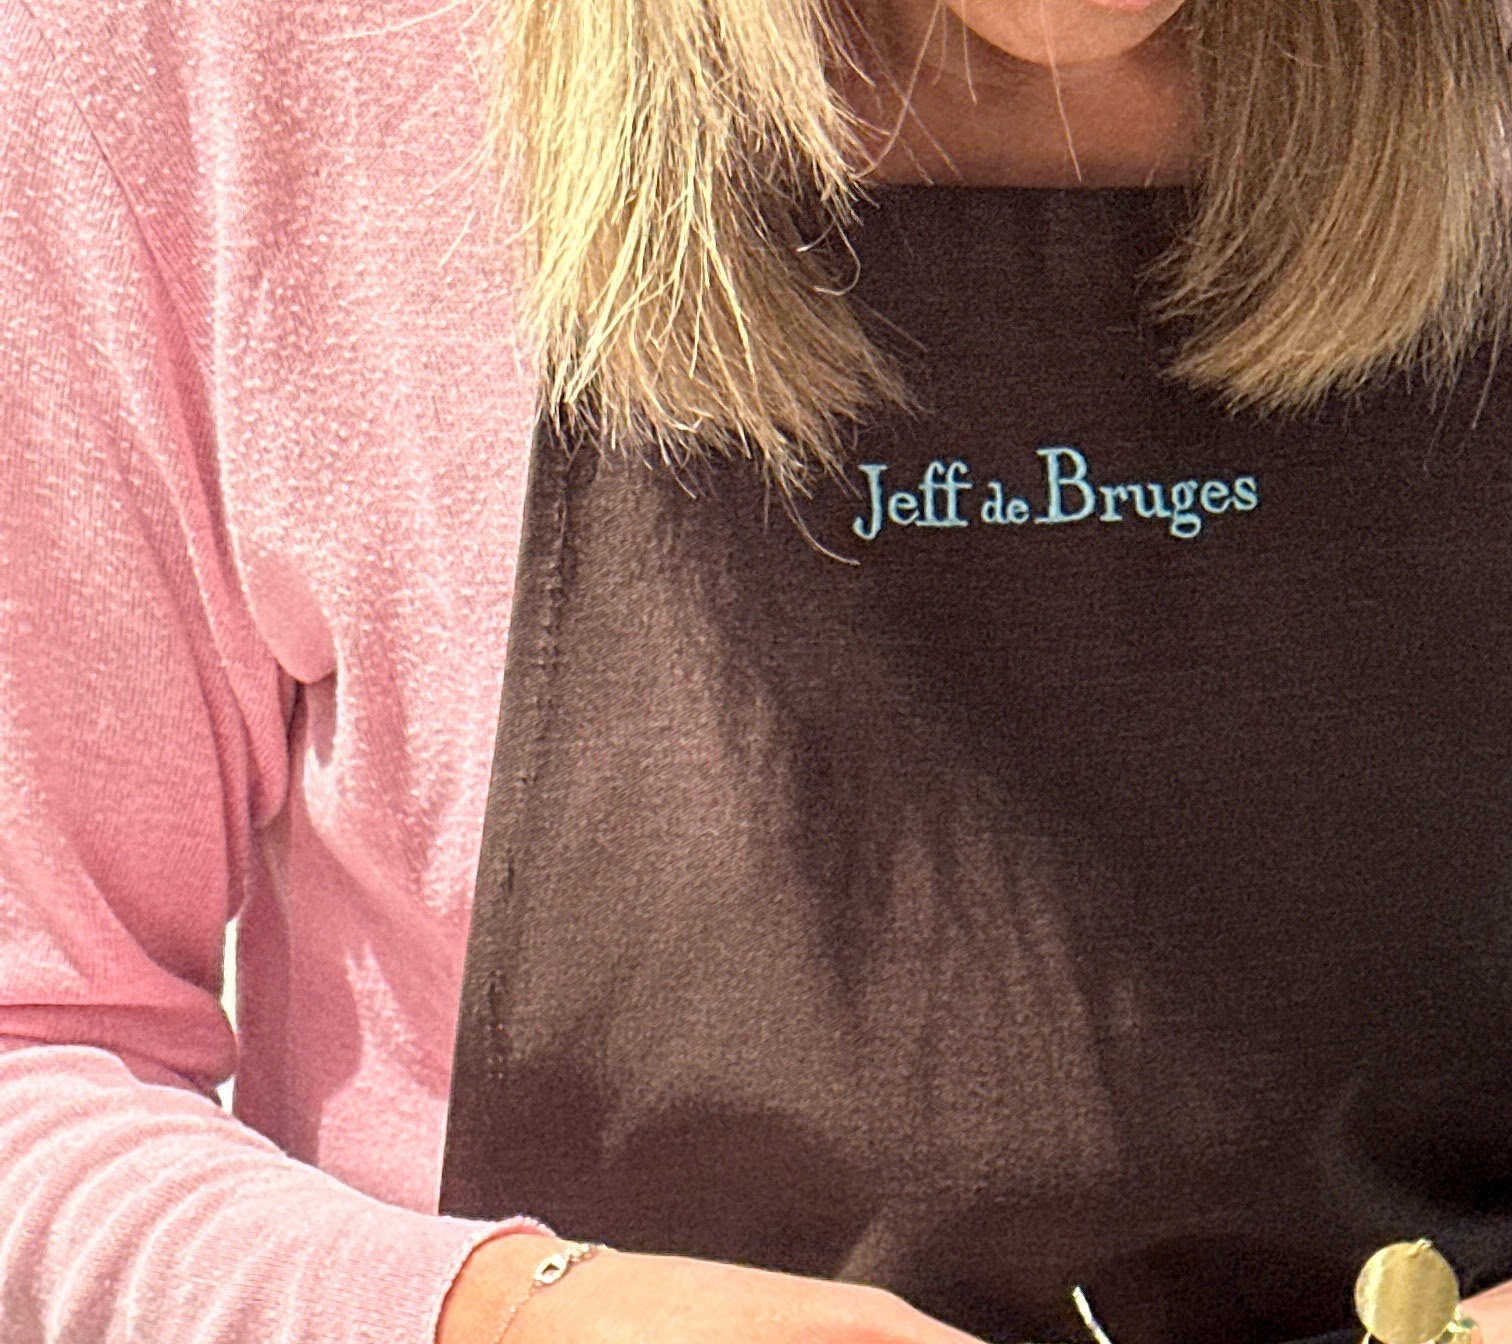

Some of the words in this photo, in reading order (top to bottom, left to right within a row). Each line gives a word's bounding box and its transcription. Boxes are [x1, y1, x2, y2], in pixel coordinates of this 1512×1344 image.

[853, 460, 974, 541] Jeff
[980, 482, 1031, 525] de
[1034, 445, 1260, 539] Bruges
